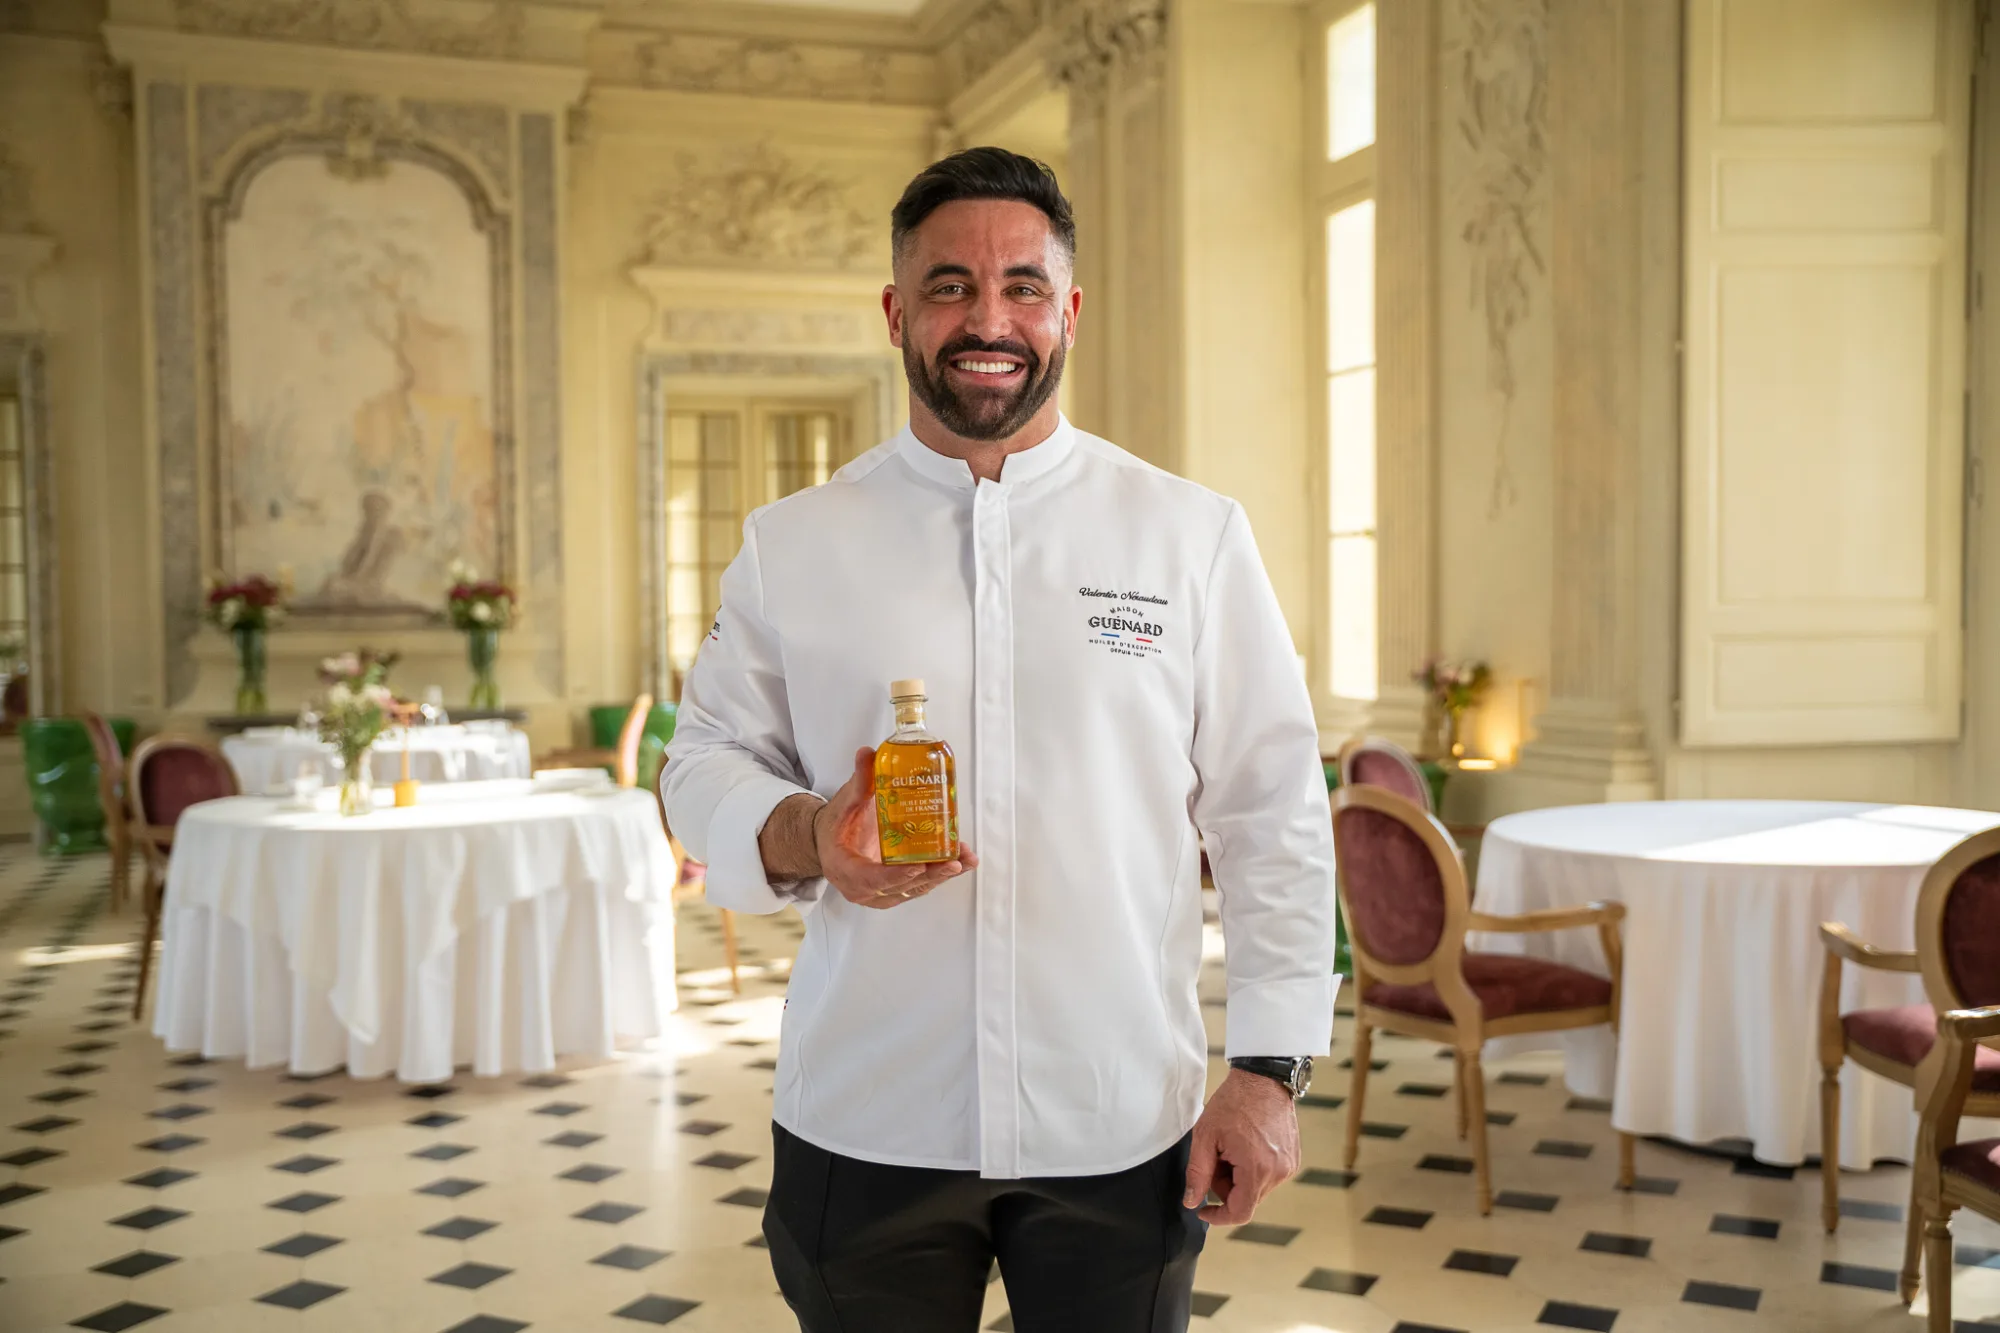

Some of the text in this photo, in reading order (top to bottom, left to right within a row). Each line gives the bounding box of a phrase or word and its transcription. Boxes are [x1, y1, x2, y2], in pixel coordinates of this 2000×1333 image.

[1079, 587, 1118, 599] Valentin
[1109, 606, 1144, 618] MAISON
[1088, 616, 1163, 637] GUÉNARD
